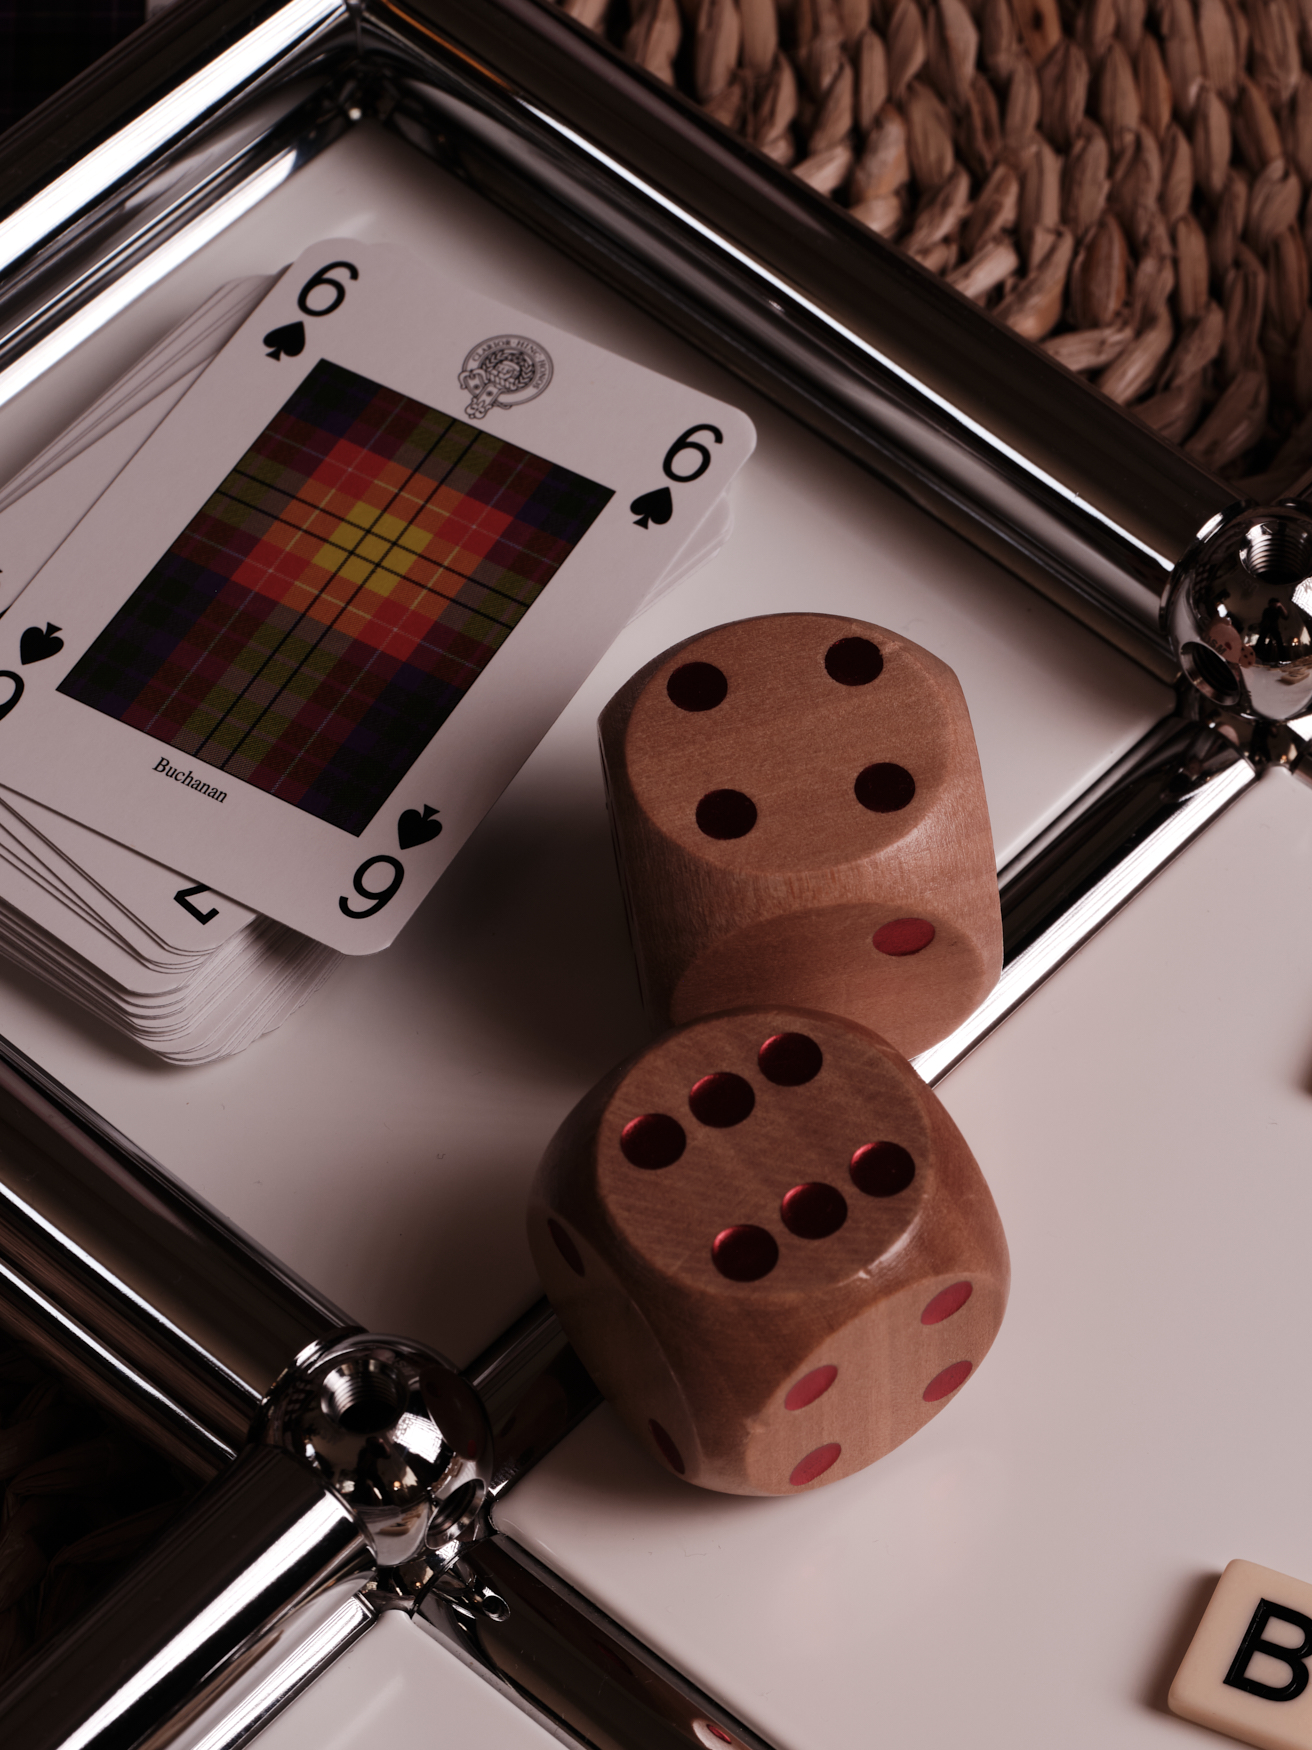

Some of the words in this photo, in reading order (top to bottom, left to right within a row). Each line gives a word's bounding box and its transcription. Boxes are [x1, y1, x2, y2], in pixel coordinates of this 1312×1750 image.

[298, 260, 359, 317] 6
[472, 339, 511, 362] CLARIOR
[662, 423, 724, 483] 6
[152, 756, 228, 803] Buchanan
